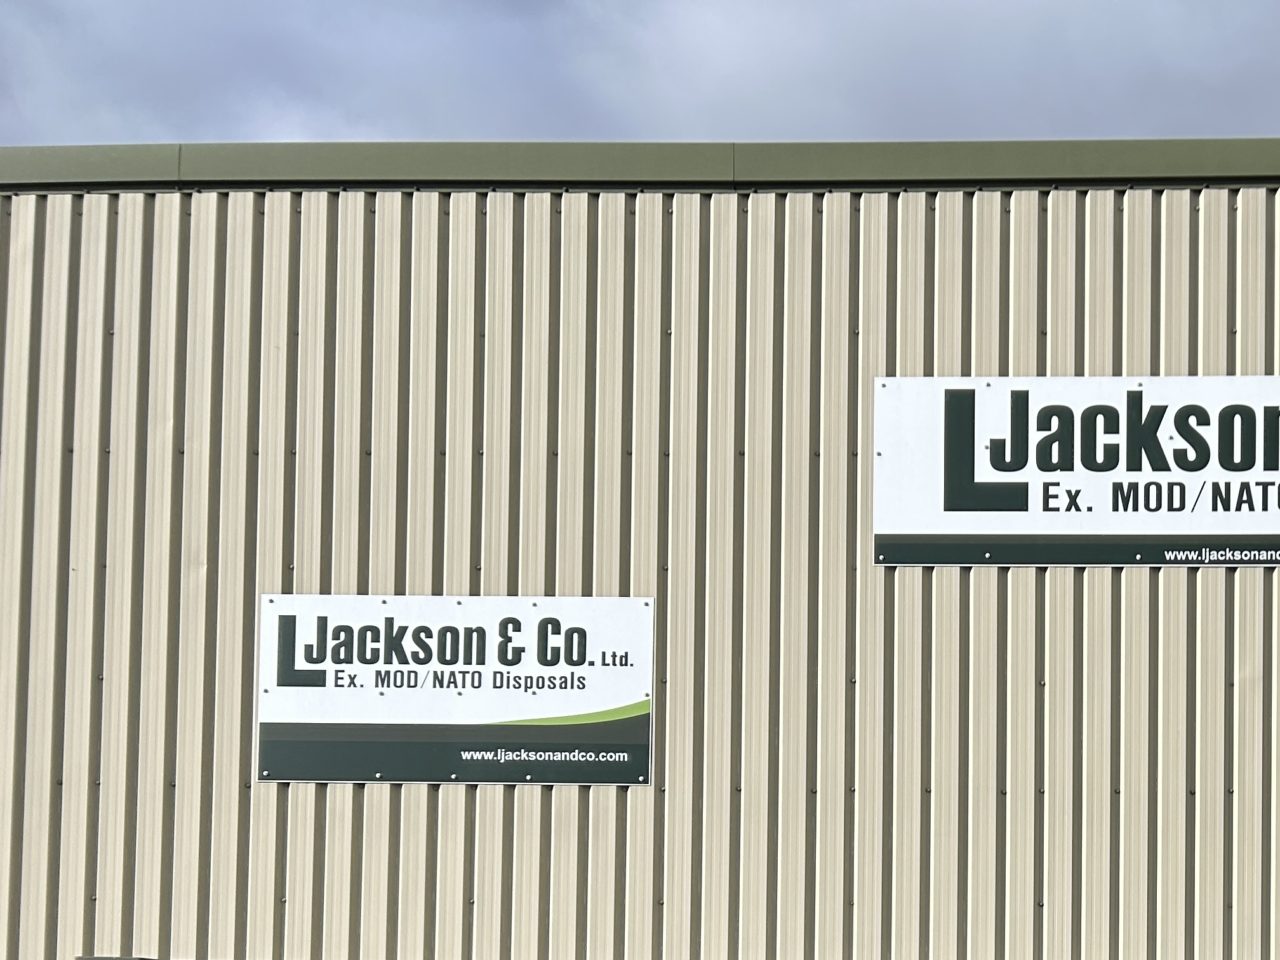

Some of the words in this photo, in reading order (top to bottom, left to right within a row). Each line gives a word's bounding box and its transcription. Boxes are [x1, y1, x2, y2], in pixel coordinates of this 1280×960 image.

[1042, 481, 1093, 513] Ex.
[497, 616, 526, 667] &
[536, 617, 595, 667] Co.
[601, 651, 634, 667] Ltd.
[334, 670, 364, 688] Ex.
[374, 670, 482, 689] MOD/NATO
[492, 671, 586, 692] Disposals
[460, 748, 628, 763] www.ljacksonandco.com
